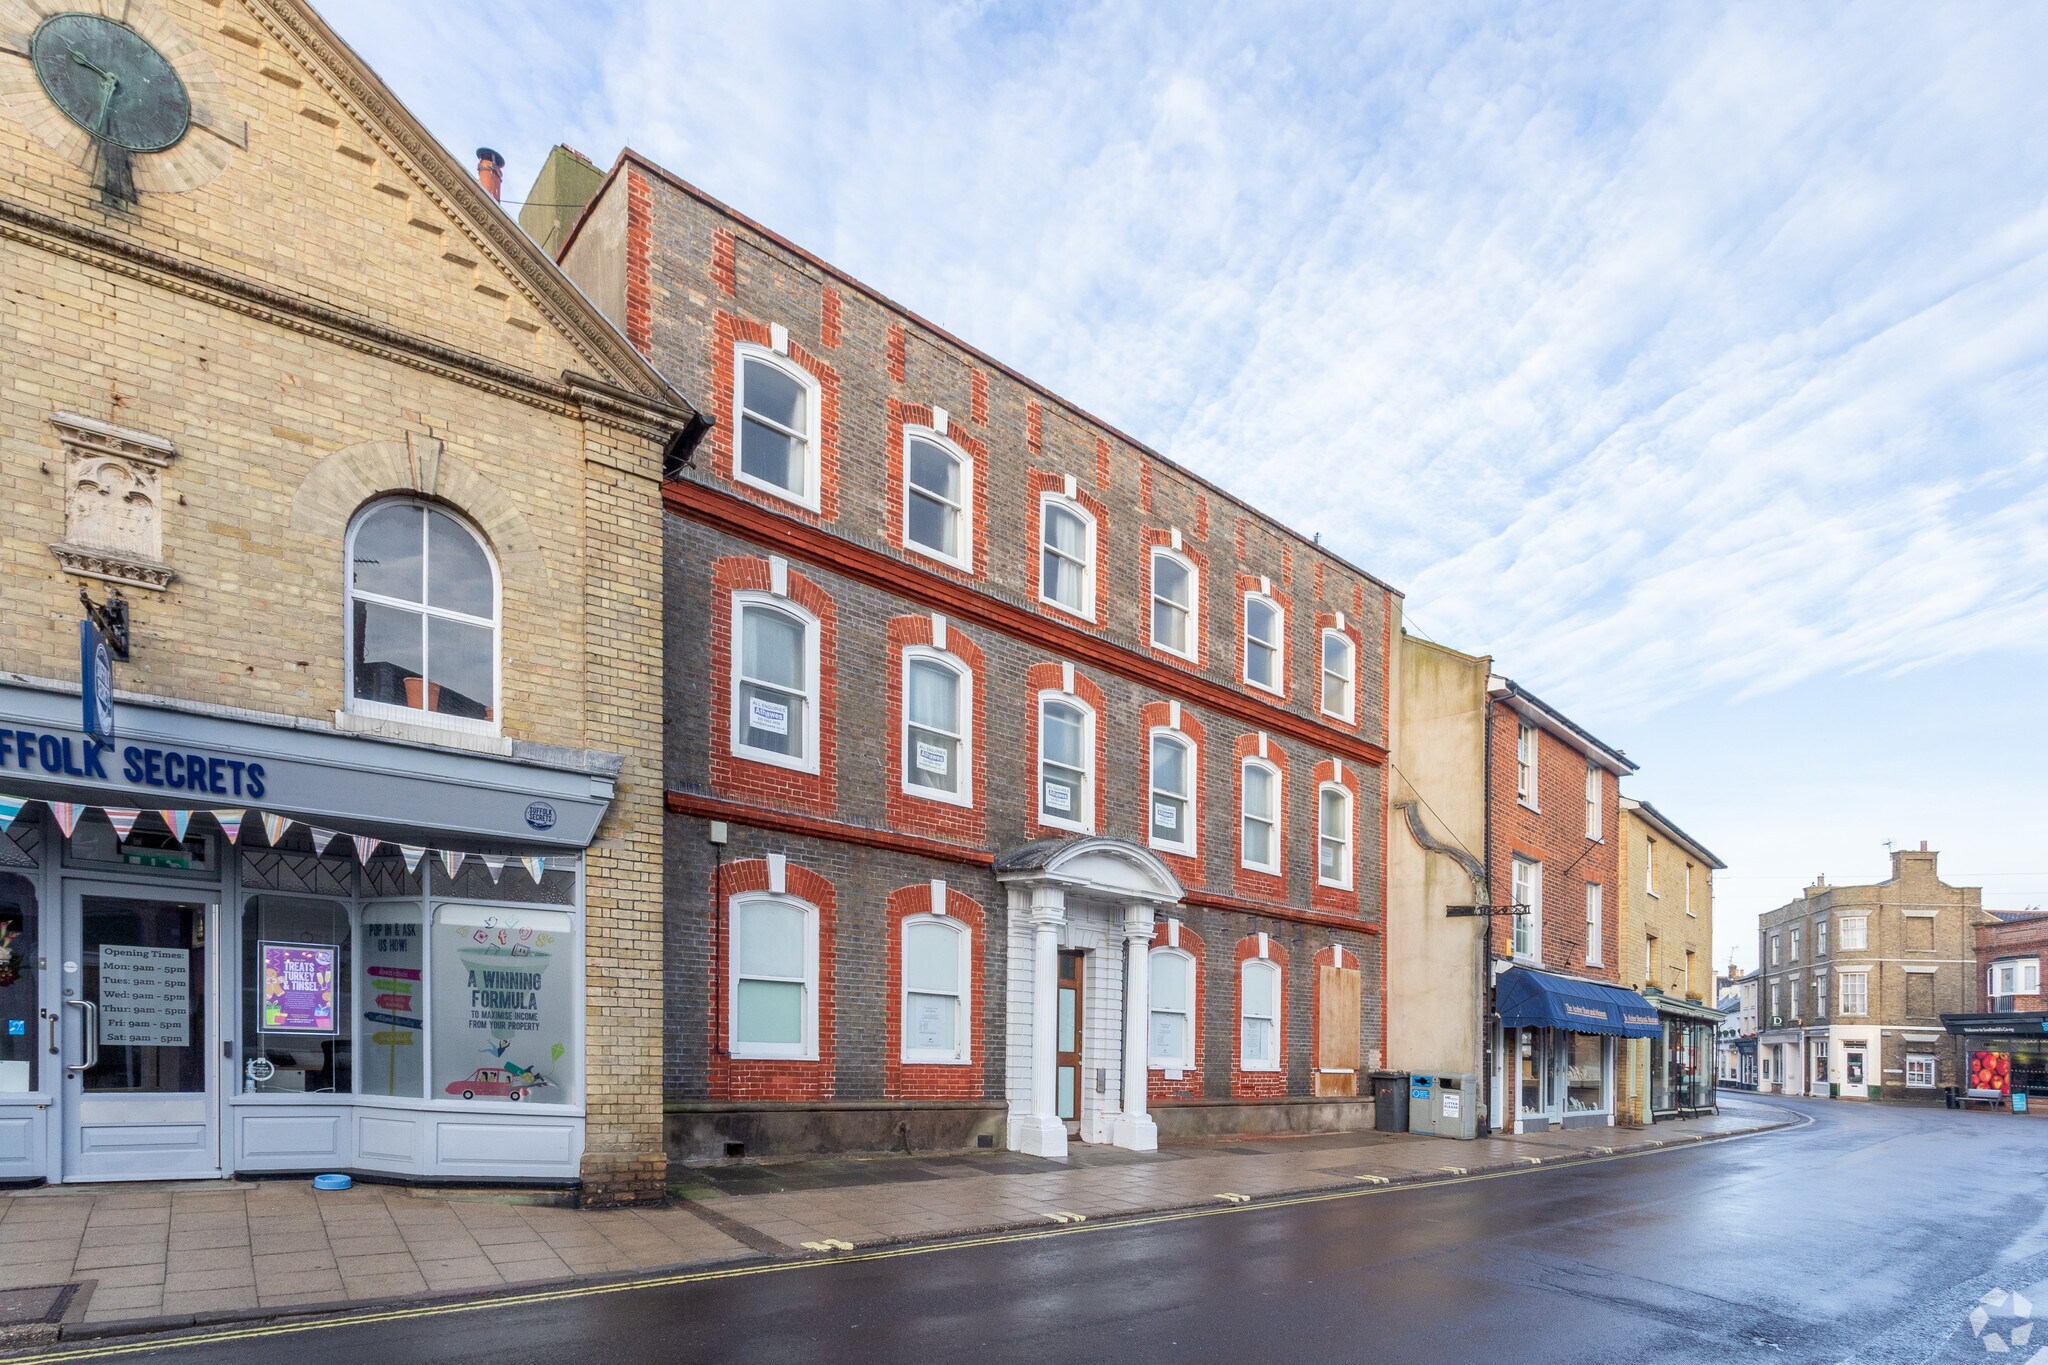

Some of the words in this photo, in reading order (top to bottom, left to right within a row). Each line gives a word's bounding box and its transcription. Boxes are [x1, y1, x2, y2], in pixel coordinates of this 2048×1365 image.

[123, 746, 265, 799] SECRETS
[530, 806, 552, 815] SUFFOLK
[529, 813, 552, 823] SECRETS
[369, 923, 382, 936] POP
[384, 924, 391, 936] IN
[394, 923, 400, 936] &
[402, 923, 416, 937] ASK
[378, 939, 387, 952] US
[389, 939, 408, 952] HOW!
[104, 947, 149, 959] Opening
[151, 951, 184, 959] Times:
[103, 962, 130, 971] Mon:
[133, 964, 154, 972] 9am
[164, 966, 186, 974] 5pm
[284, 961, 314, 972] TREATS
[102, 976, 130, 984] Tues:
[164, 980, 186, 988] 5pm
[284, 971, 314, 982] TURKEY
[467, 970, 477, 987] A
[483, 970, 541, 990] WINNING
[283, 981, 289, 991] &
[291, 981, 318, 992] TINSEL
[103, 990, 129, 998] Wed:
[164, 994, 185, 1002] 5pm
[472, 990, 537, 1010] FORMULA
[102, 1004, 131, 1012] Thur:
[471, 1010, 479, 1018] TO
[481, 1010, 512, 1020] MAXIMISE
[514, 1012, 538, 1021] INCOME
[108, 1019, 126, 1027] Fri:
[468, 1020, 487, 1029] FROM
[489, 1021, 505, 1030] YOUR
[508, 1022, 540, 1031] PROPERTY
[107, 1033, 126, 1041] Sat:
